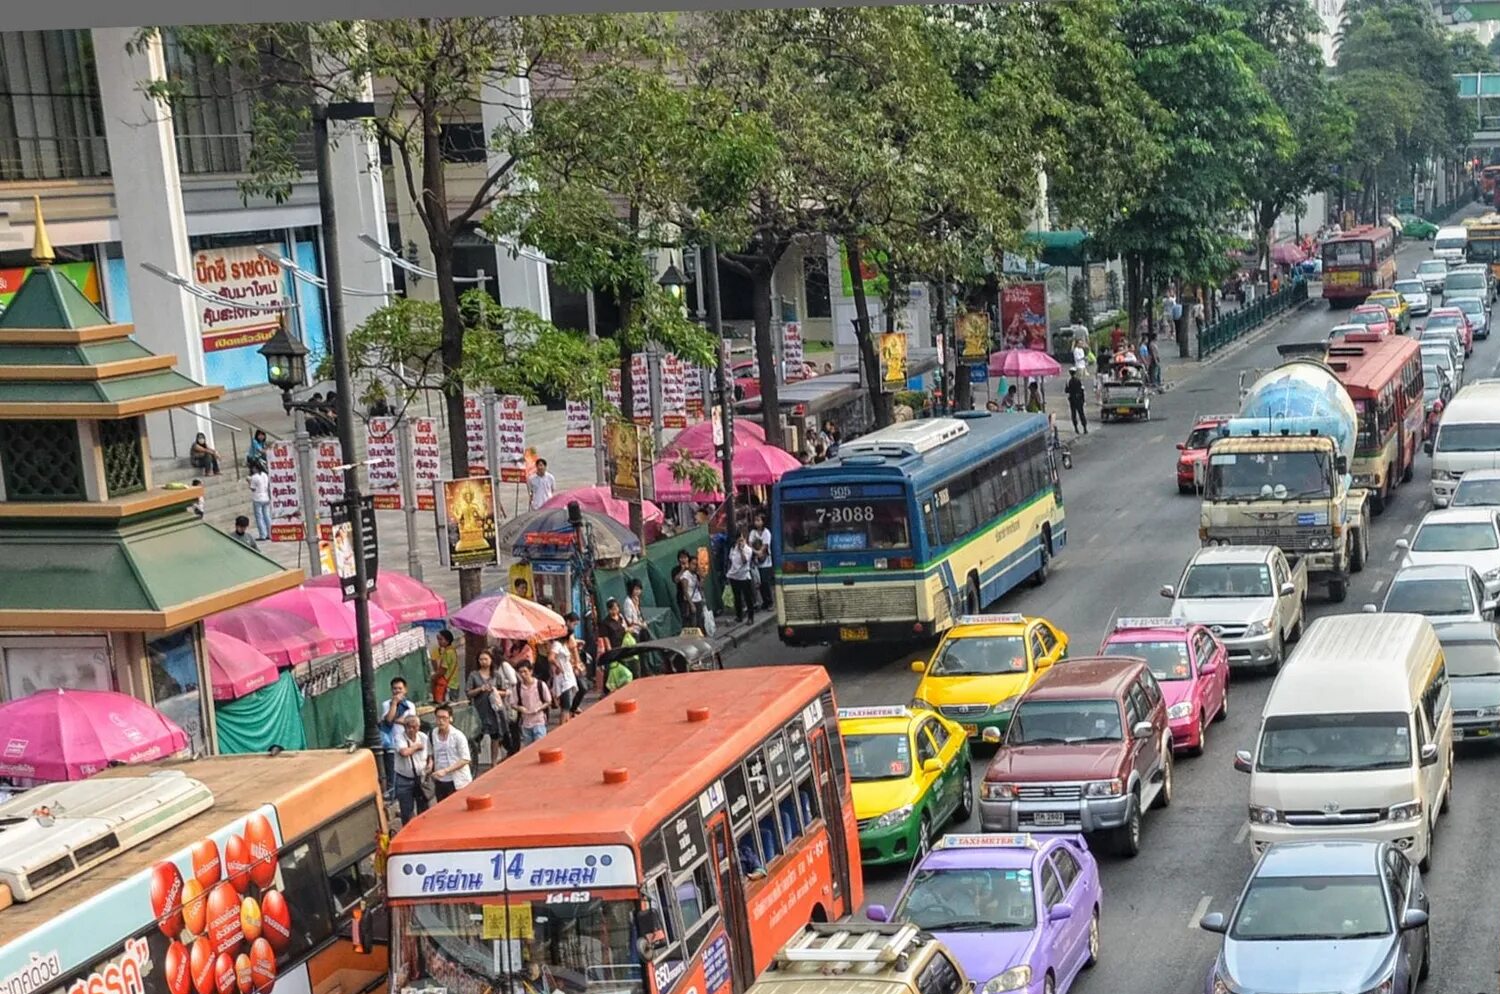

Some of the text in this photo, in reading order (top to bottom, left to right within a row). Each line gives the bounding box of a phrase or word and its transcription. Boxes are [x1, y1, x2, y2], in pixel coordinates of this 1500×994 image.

[815, 505, 875, 523] 7-3088
[421, 869, 483, 892] ศรีย่าน
[490, 852, 525, 881] 14
